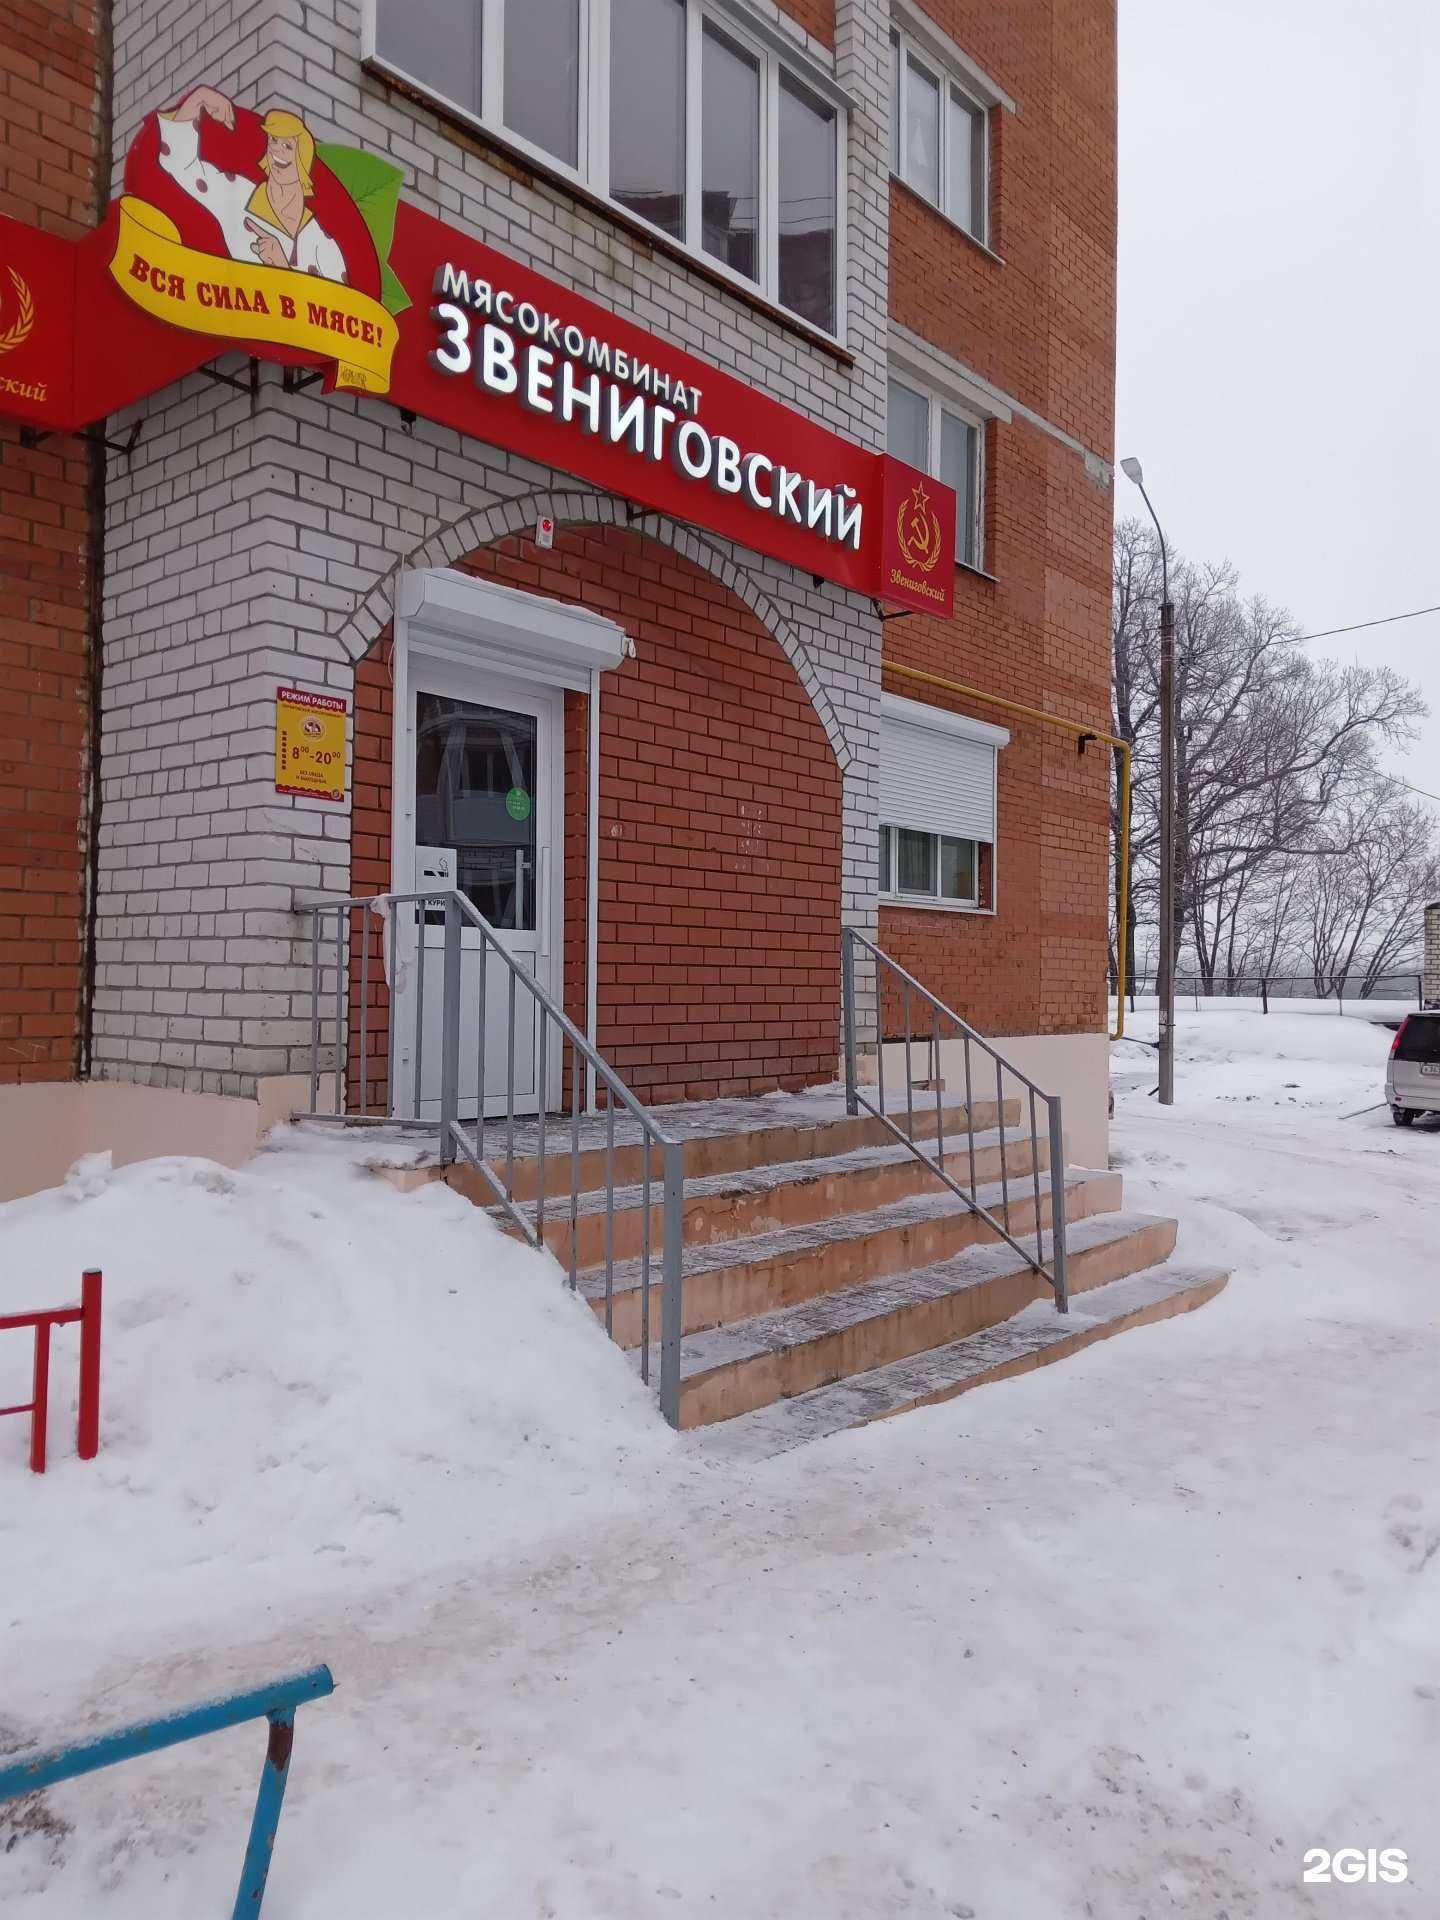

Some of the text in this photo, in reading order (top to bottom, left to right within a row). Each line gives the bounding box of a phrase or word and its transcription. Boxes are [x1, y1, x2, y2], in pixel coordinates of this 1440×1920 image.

[128, 253, 384, 348] ВСЯ СИЛА В МЯСЕ!
[437, 261, 703, 417] МЯСОКОМБИНАТ
[432, 302, 865, 552] ЗВЕНИГОВСКИЙ
[890, 568, 945, 602] Звениговский
[281, 690, 344, 710] РЕЖИМ РАБОТЫ
